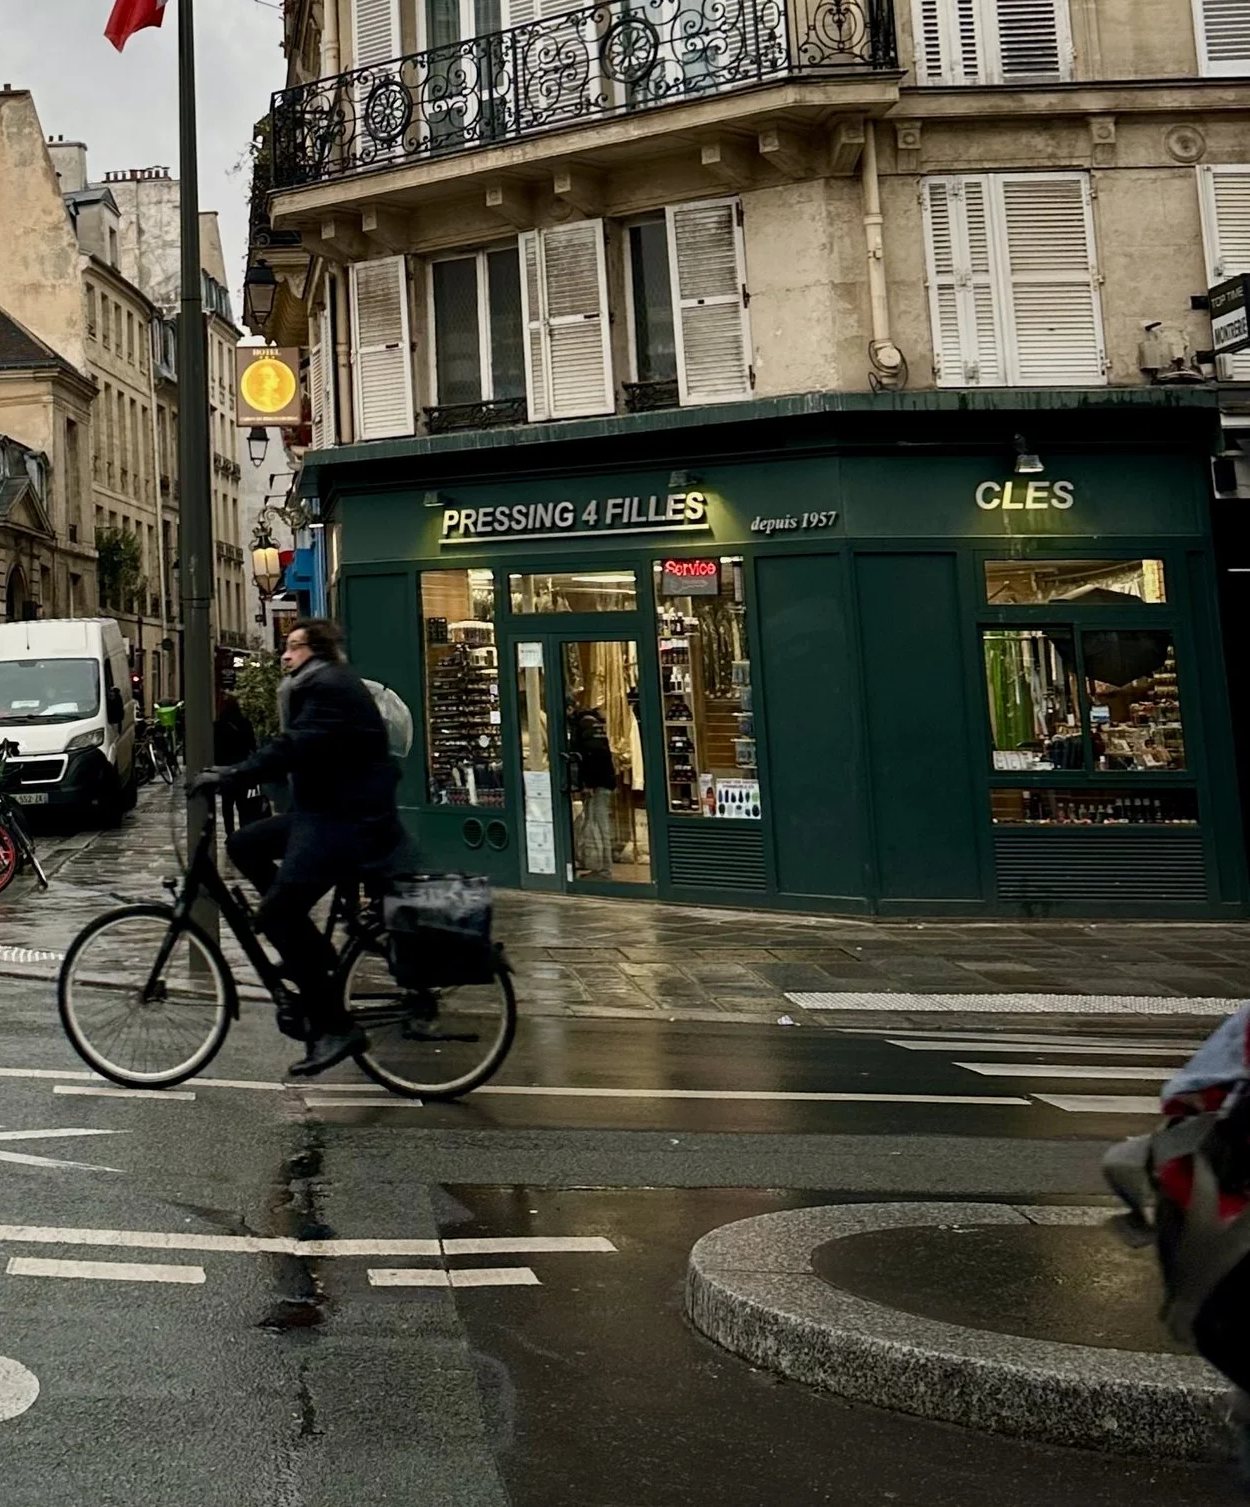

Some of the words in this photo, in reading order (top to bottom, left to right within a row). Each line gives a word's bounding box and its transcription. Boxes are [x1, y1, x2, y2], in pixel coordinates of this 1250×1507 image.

[1211, 294, 1226, 308] TOP
[1226, 286, 1244, 302] TIME
[975, 481, 1074, 510] CLES
[442, 501, 574, 535] PRESSING
[581, 500, 598, 525] 4
[605, 492, 704, 524] FILLES
[750, 514, 798, 533] depuis
[800, 511, 837, 528] 1957
[665, 559, 717, 576] Service
